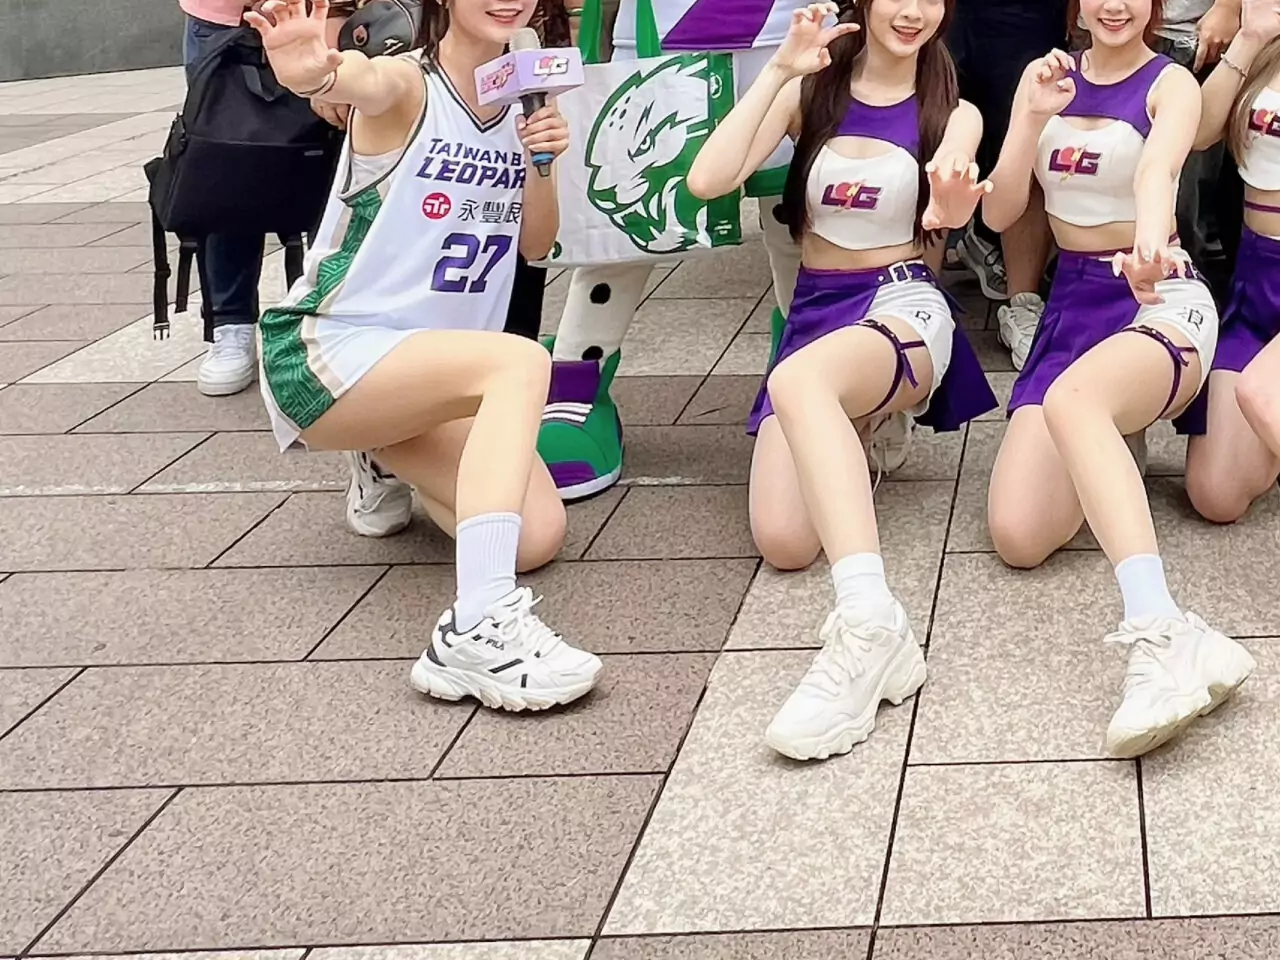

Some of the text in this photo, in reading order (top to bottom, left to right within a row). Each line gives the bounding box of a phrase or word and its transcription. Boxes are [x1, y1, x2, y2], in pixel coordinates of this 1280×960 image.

[428, 138, 508, 164] TAIWAN
[430, 232, 512, 294] 27
[485, 638, 505, 651] FILA
